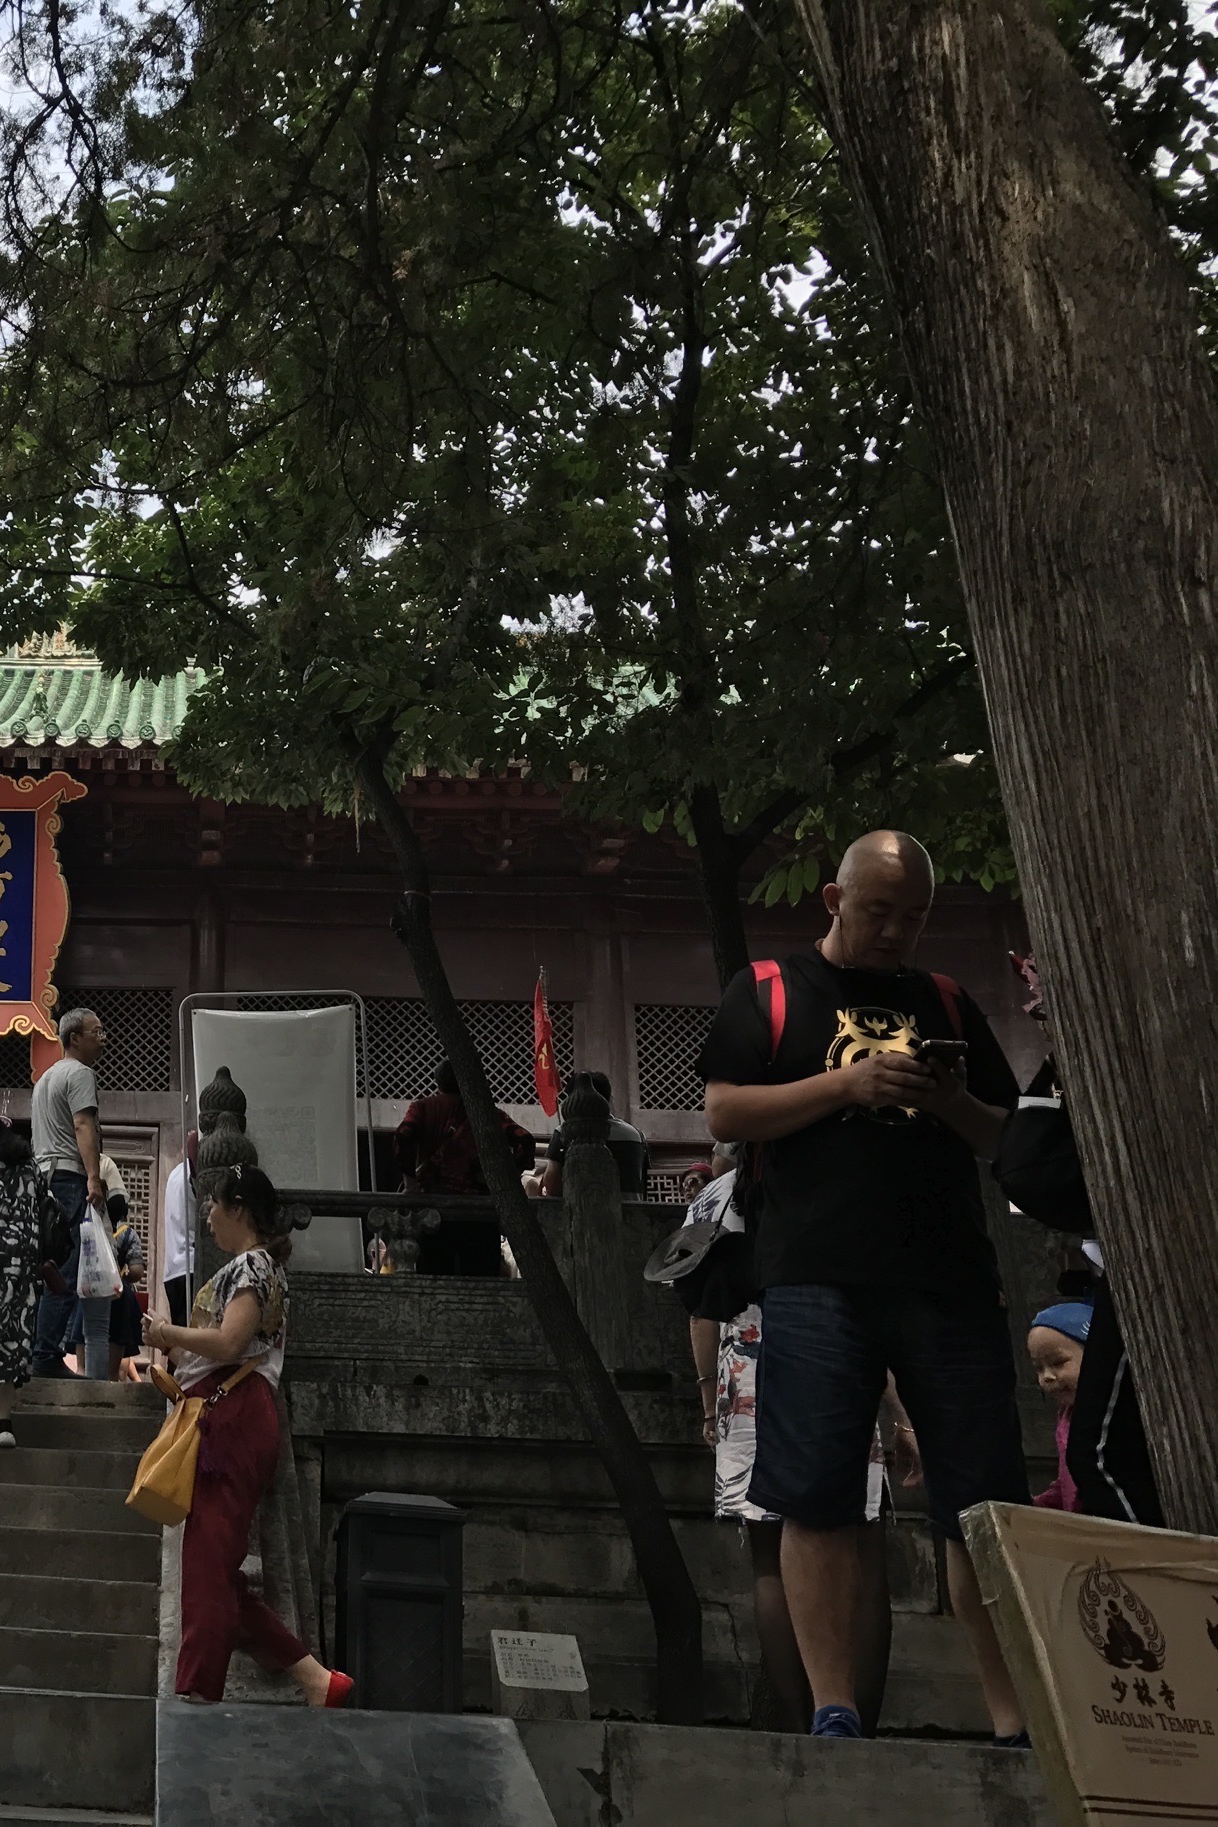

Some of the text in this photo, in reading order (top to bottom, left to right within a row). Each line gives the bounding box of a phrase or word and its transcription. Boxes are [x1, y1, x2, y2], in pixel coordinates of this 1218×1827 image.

[1110, 1674, 1176, 1711] 少林寺
[1091, 1704, 1215, 1736] SHAOLIN TEMPLE
